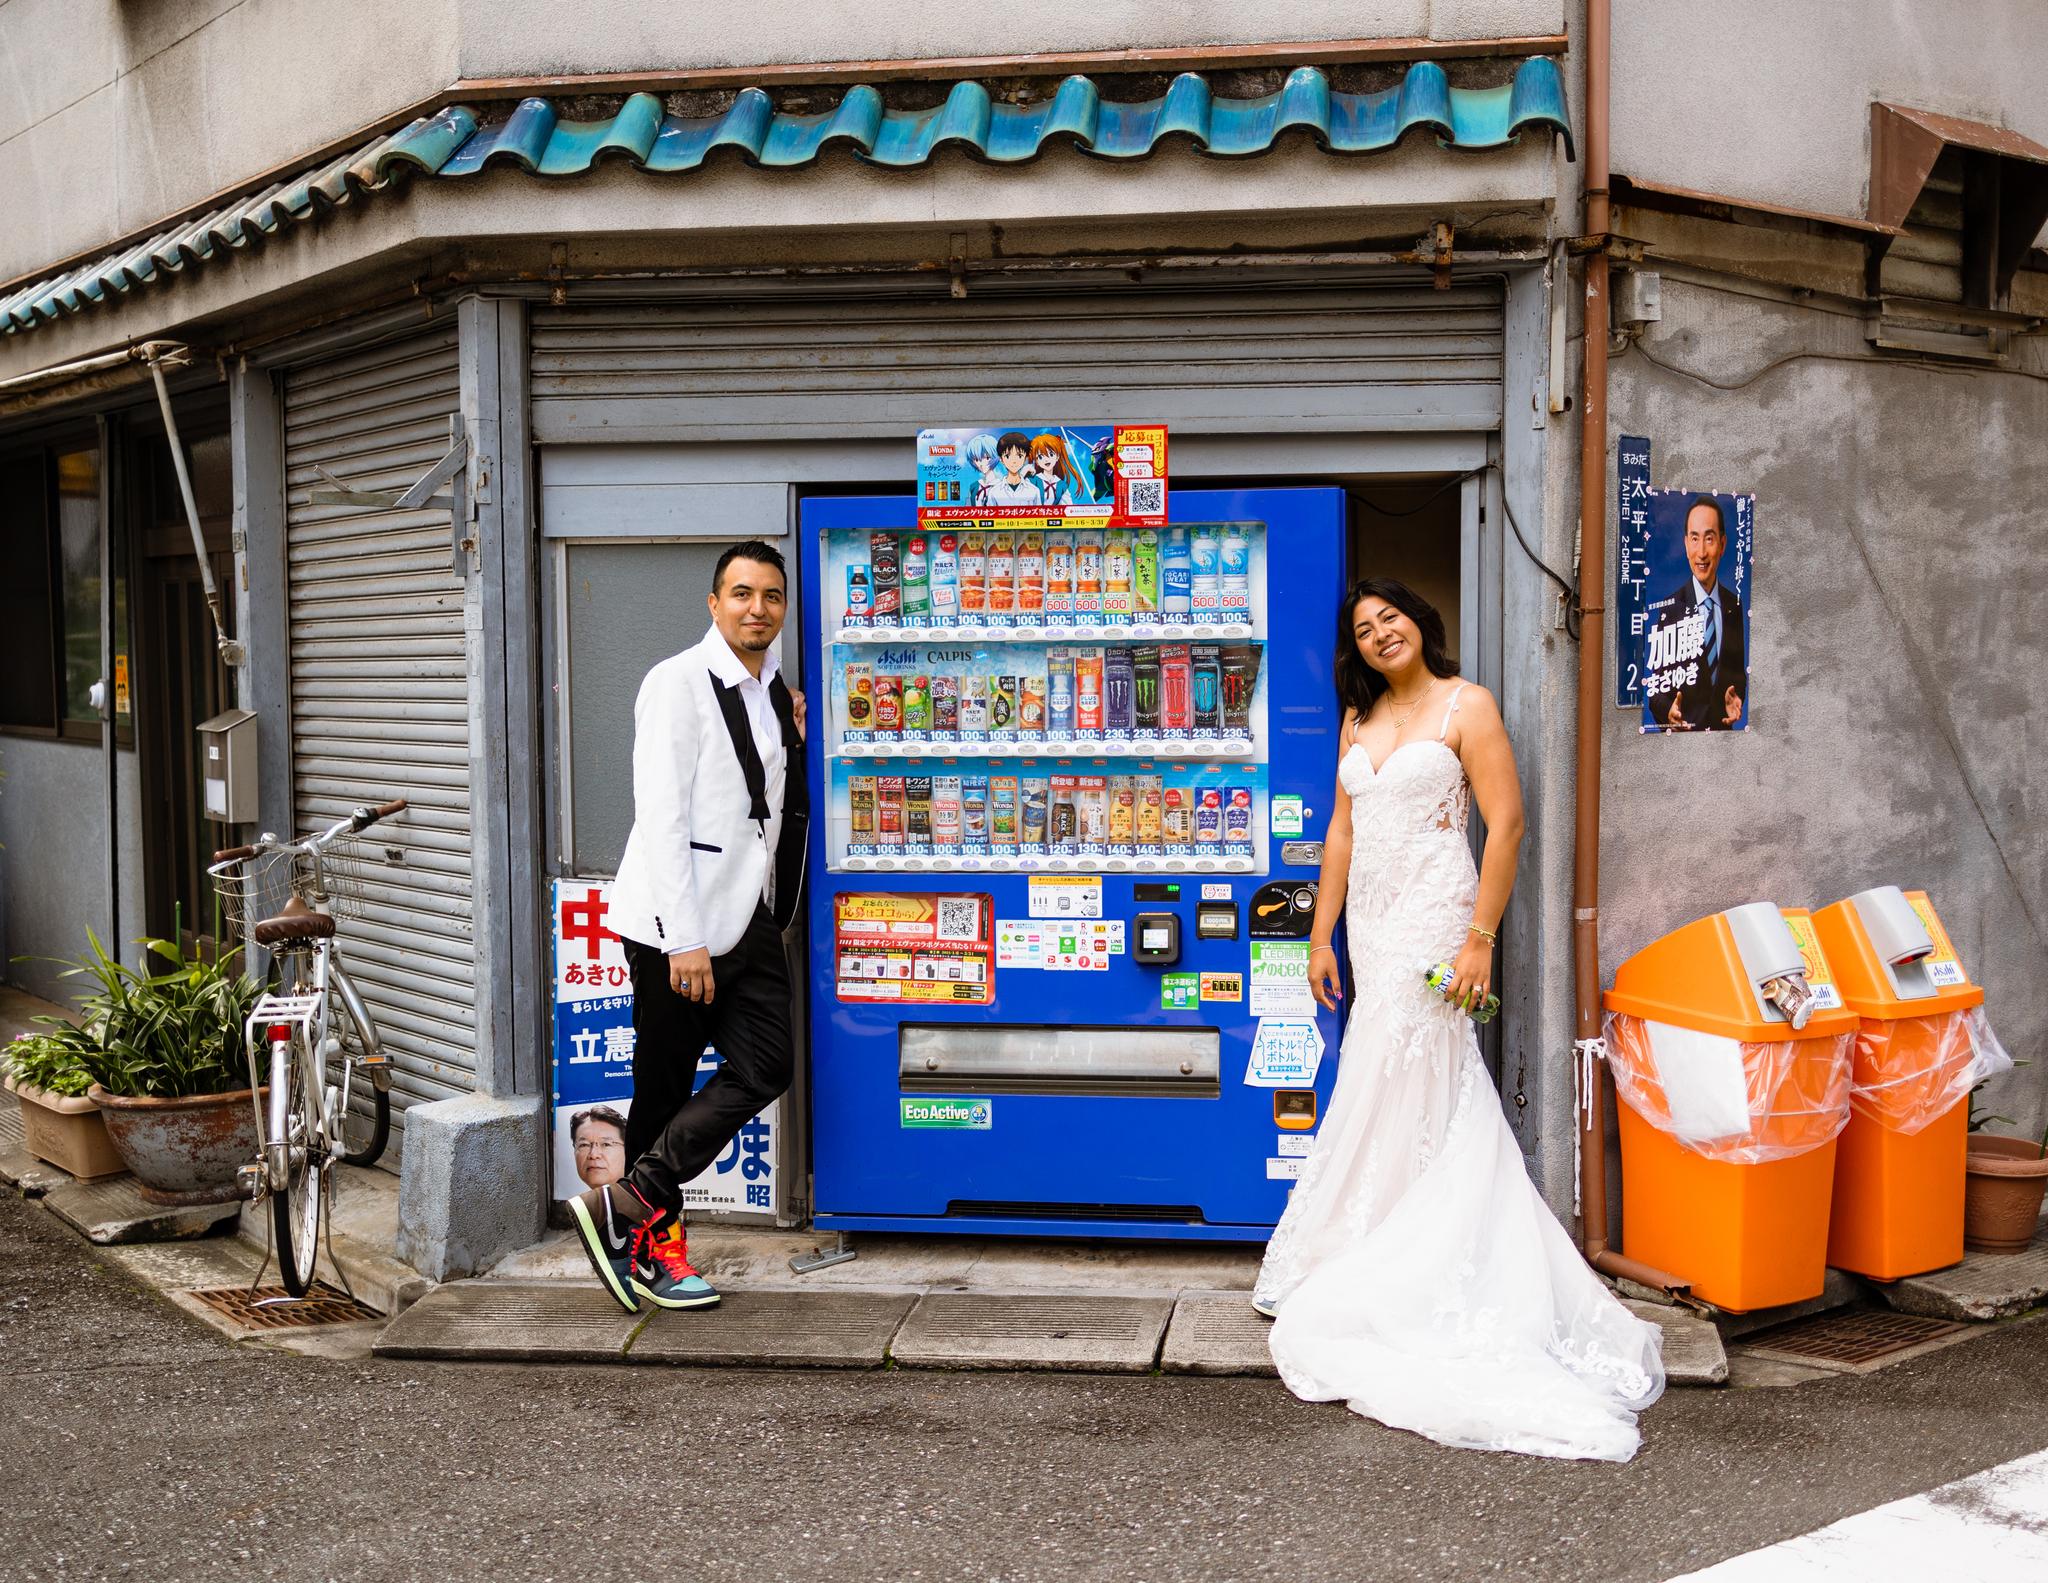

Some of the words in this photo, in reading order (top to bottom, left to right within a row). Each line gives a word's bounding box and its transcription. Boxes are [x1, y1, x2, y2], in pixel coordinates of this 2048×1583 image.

[930, 446, 954, 454] WONDA
[1622, 453, 1648, 466] すみだ
[1622, 476, 1630, 520] TAIHEI
[926, 510, 941, 518] 限定
[945, 509, 996, 517] エヴァンゲリオン
[1621, 536, 1630, 584] 2-CHOME
[1631, 476, 1646, 636] 太平二丁目
[1046, 600, 1068, 610] 600
[1076, 600, 1098, 610] 600
[1104, 600, 1127, 610] 600
[1192, 597, 1215, 607] 600
[1222, 596, 1245, 606] 600
[1646, 614, 1705, 670] 加藤
[877, 648, 916, 664] Asahi
[927, 651, 972, 664] CALPIS
[1626, 664, 1638, 691] 2
[1646, 662, 1700, 698] まさゆき
[844, 906, 916, 918] 応募はココから！
[1264, 950, 1303, 959] LED照明
[565, 962, 632, 988] あきひ
[1267, 962, 1310, 978] のむec
[1934, 964, 1955, 976] Asahi
[572, 996, 634, 1014] 暮らしを守り
[570, 1026, 636, 1064] 立憲
[1267, 1052, 1302, 1062] ボトルへ
[604, 1070, 634, 1078] Democrat
[746, 1184, 770, 1208] 昭
